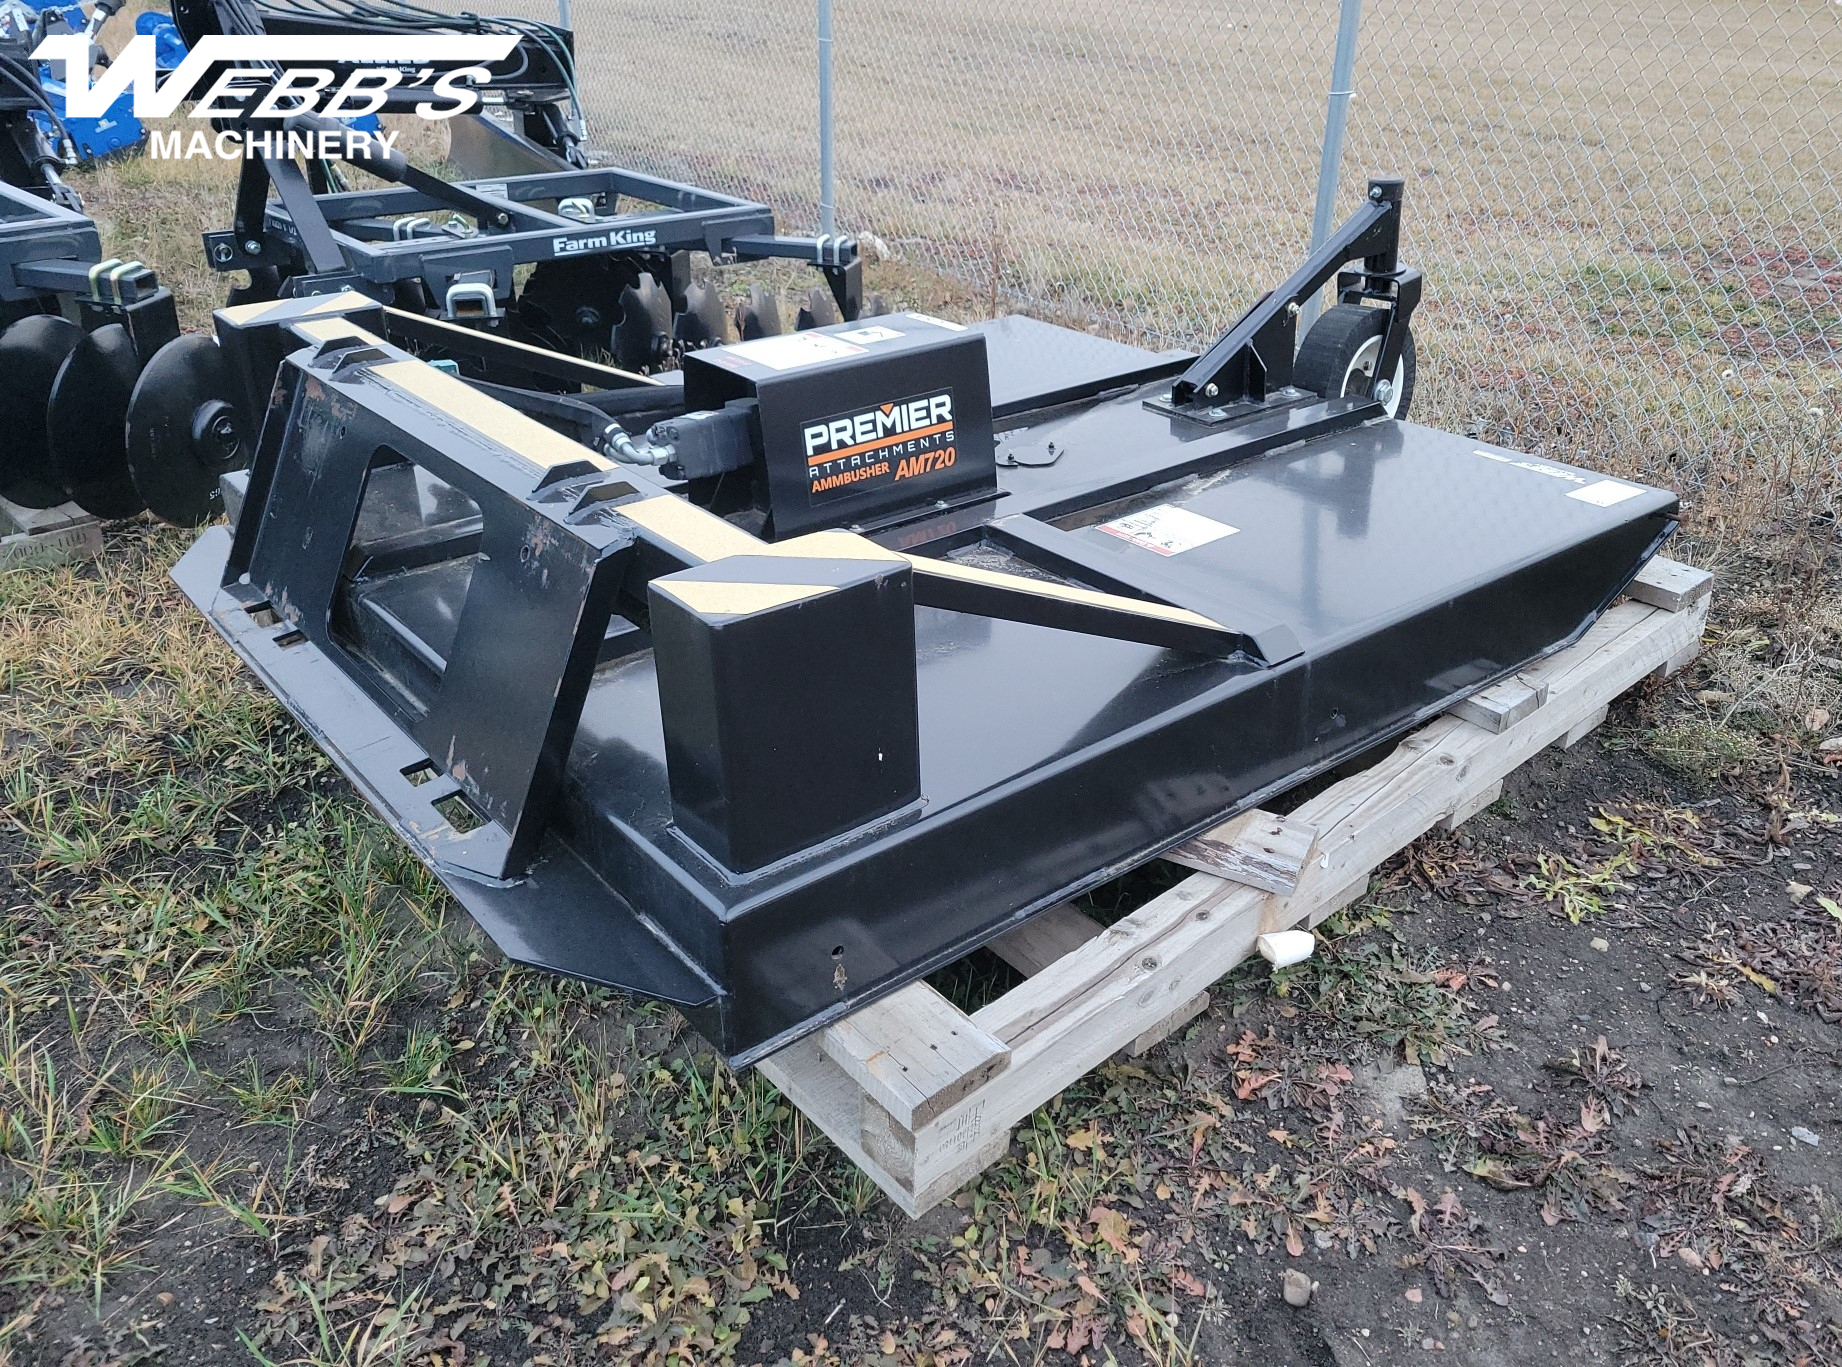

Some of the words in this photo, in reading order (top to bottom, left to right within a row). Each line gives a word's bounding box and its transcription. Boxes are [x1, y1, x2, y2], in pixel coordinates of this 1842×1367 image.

[553, 236, 608, 253] Farm
[609, 229, 657, 246] King
[804, 394, 953, 456] PREMIER
[809, 430, 955, 478] ATTACHMENTS
[812, 461, 891, 494] AMMBUSHER
[894, 446, 956, 482] AM720
